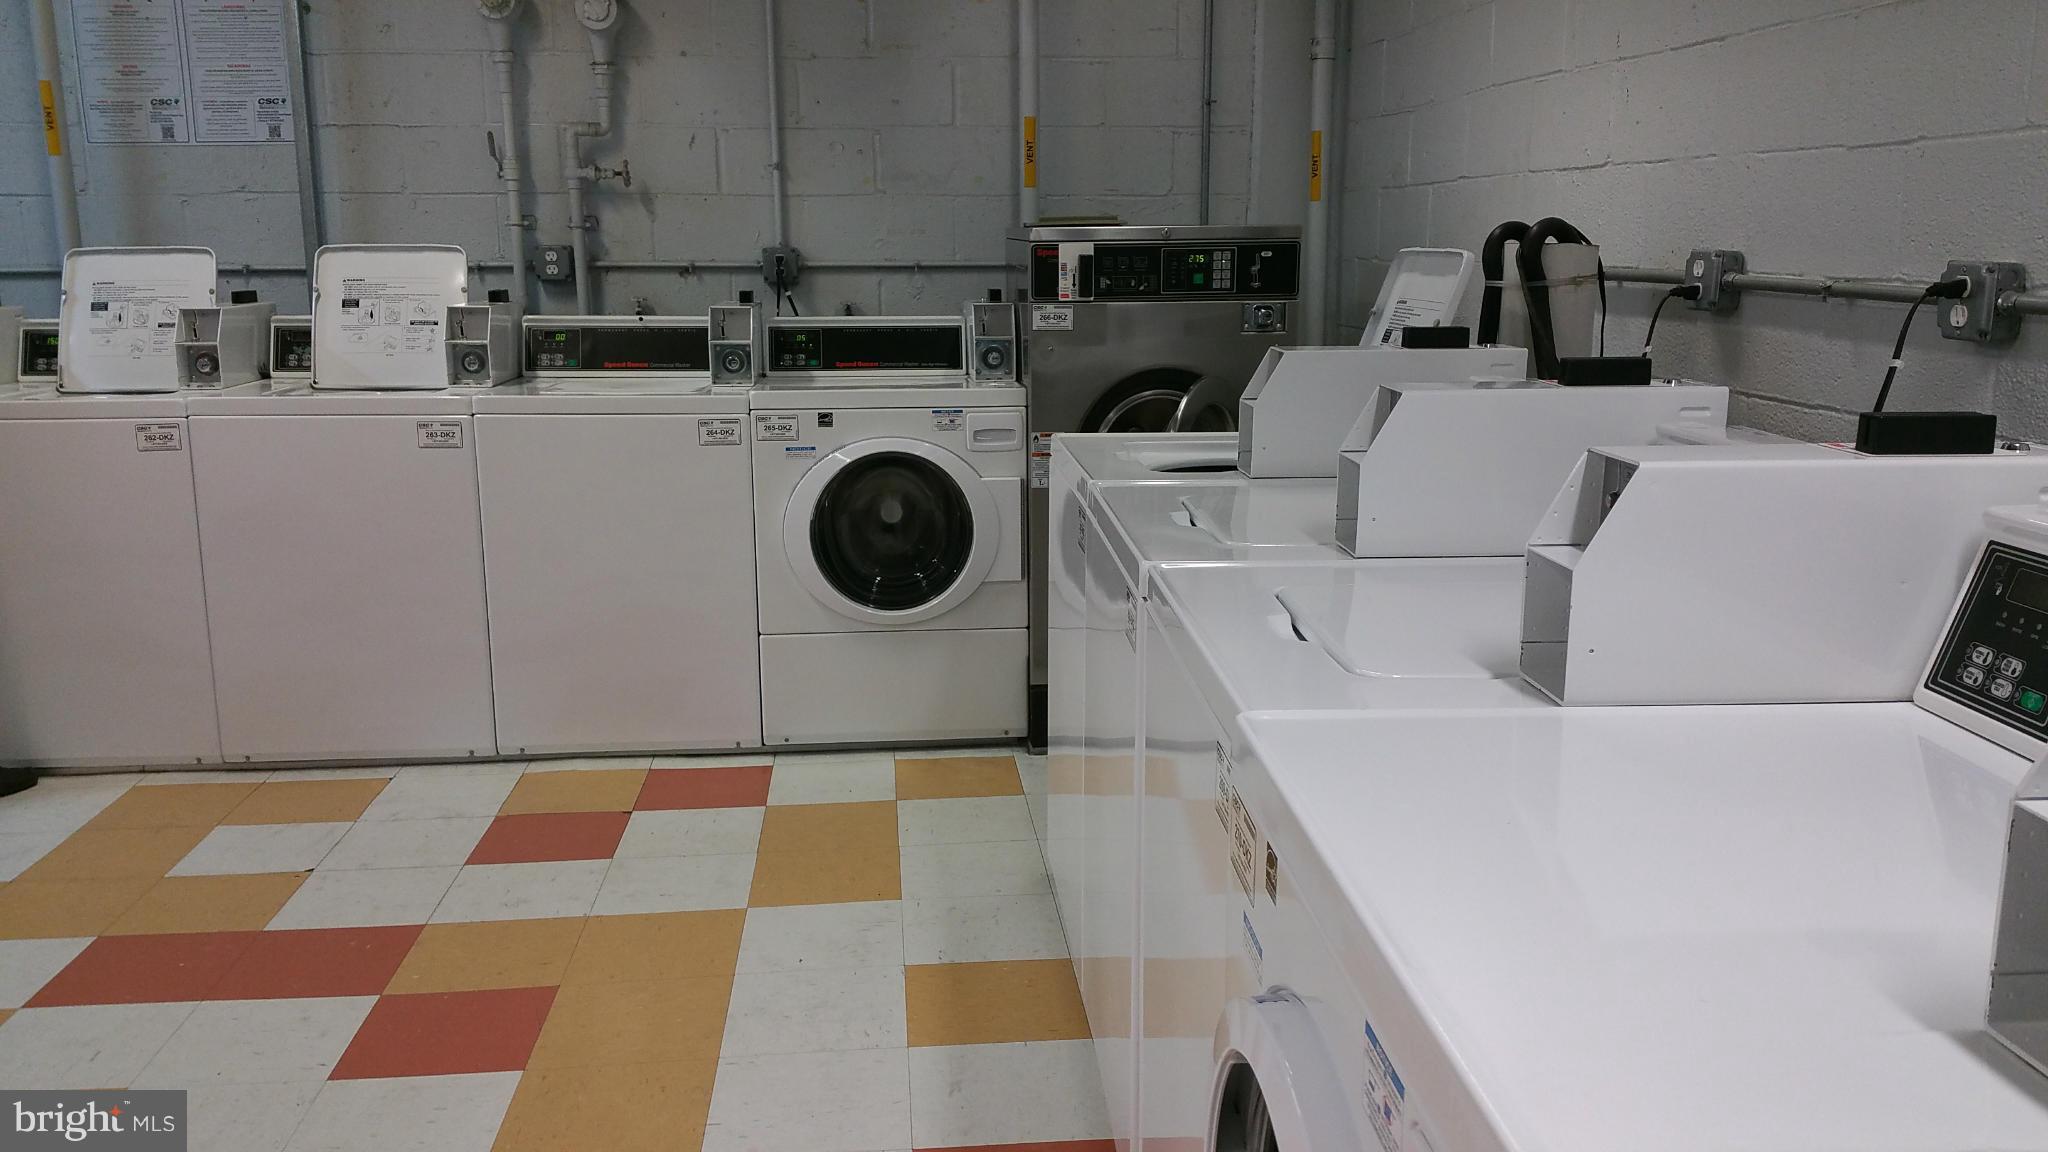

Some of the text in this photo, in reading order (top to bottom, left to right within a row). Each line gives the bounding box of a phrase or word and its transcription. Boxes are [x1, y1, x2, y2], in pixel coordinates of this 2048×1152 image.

[150, 98, 173, 106] CSC
[43, 106, 55, 131] VENT
[1025, 140, 1034, 165] VENT
[1311, 155, 1319, 178] VENT
